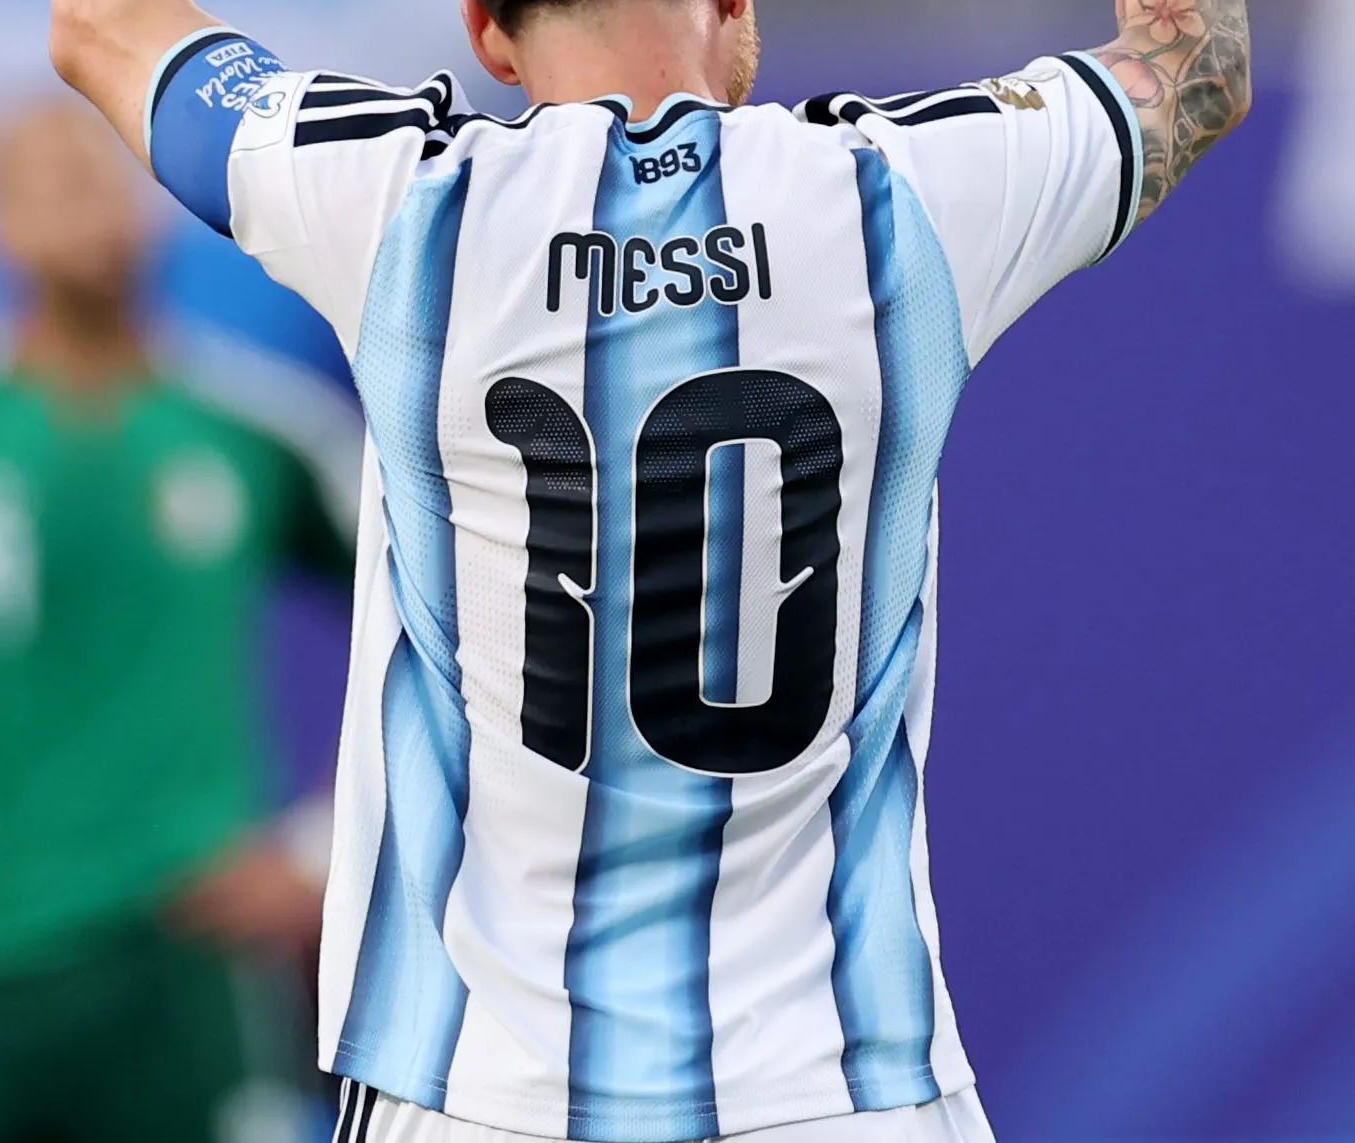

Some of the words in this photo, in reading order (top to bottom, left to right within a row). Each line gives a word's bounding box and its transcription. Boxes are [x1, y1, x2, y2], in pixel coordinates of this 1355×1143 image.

[195, 57, 263, 108] World
[632, 142, 702, 185] 1893
[544, 221, 773, 317] MESSI
[483, 366, 846, 777] 10
